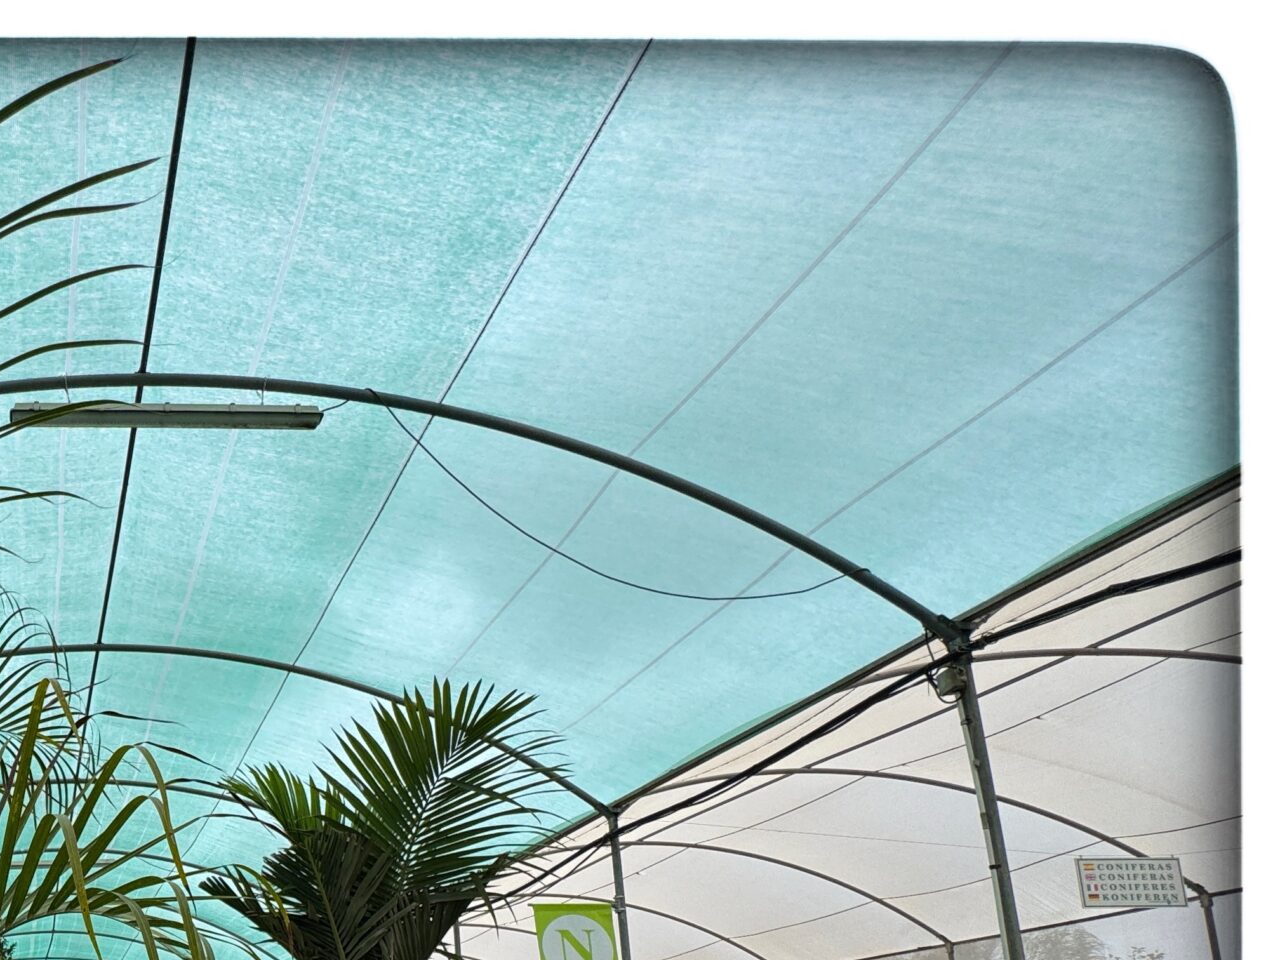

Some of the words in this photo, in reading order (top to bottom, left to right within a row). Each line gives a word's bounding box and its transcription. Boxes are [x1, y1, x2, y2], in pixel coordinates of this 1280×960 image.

[1097, 863, 1173, 871] CONIFERAS
[1098, 873, 1175, 881] CONIFERAS
[1100, 883, 1177, 891] CONIFERES
[1102, 893, 1179, 901] KONIFEREN
